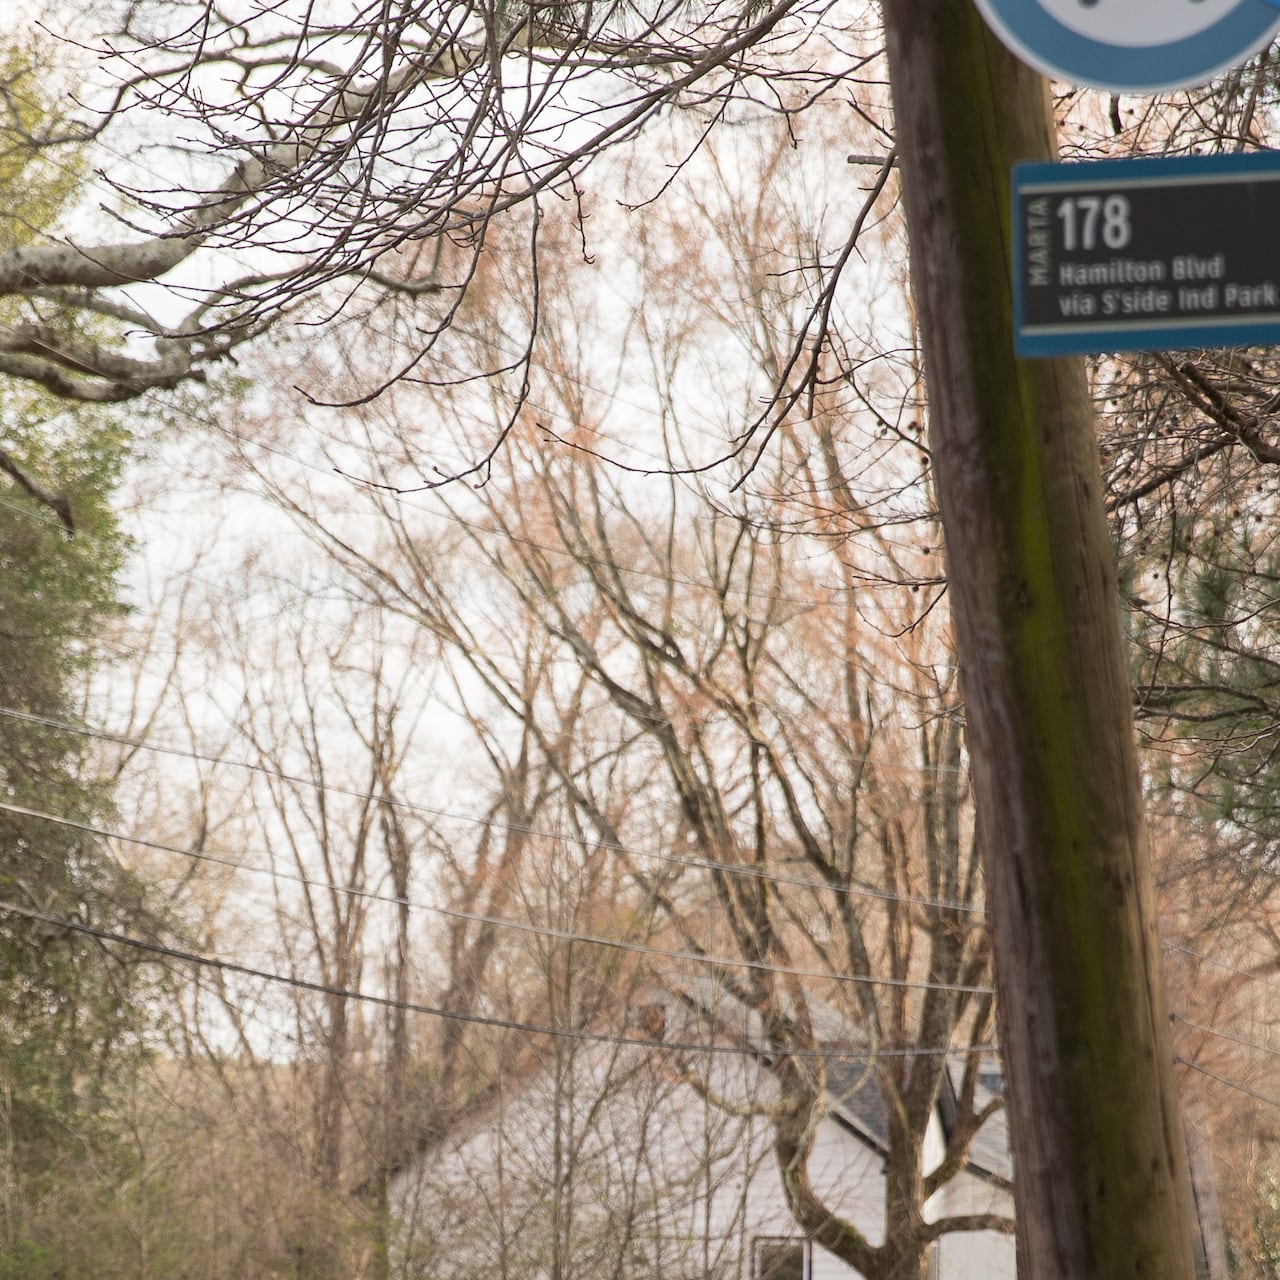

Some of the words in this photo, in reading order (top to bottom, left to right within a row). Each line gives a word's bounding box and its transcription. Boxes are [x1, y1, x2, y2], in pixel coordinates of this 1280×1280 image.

[1028, 197, 1049, 286] MARTA
[1057, 194, 1131, 250] 178
[1059, 258, 1164, 286] Hamilton
[1172, 253, 1224, 280] Blvd
[1059, 292, 1095, 317] via
[1178, 286, 1216, 311] Ind
[1224, 282, 1278, 308] Park
